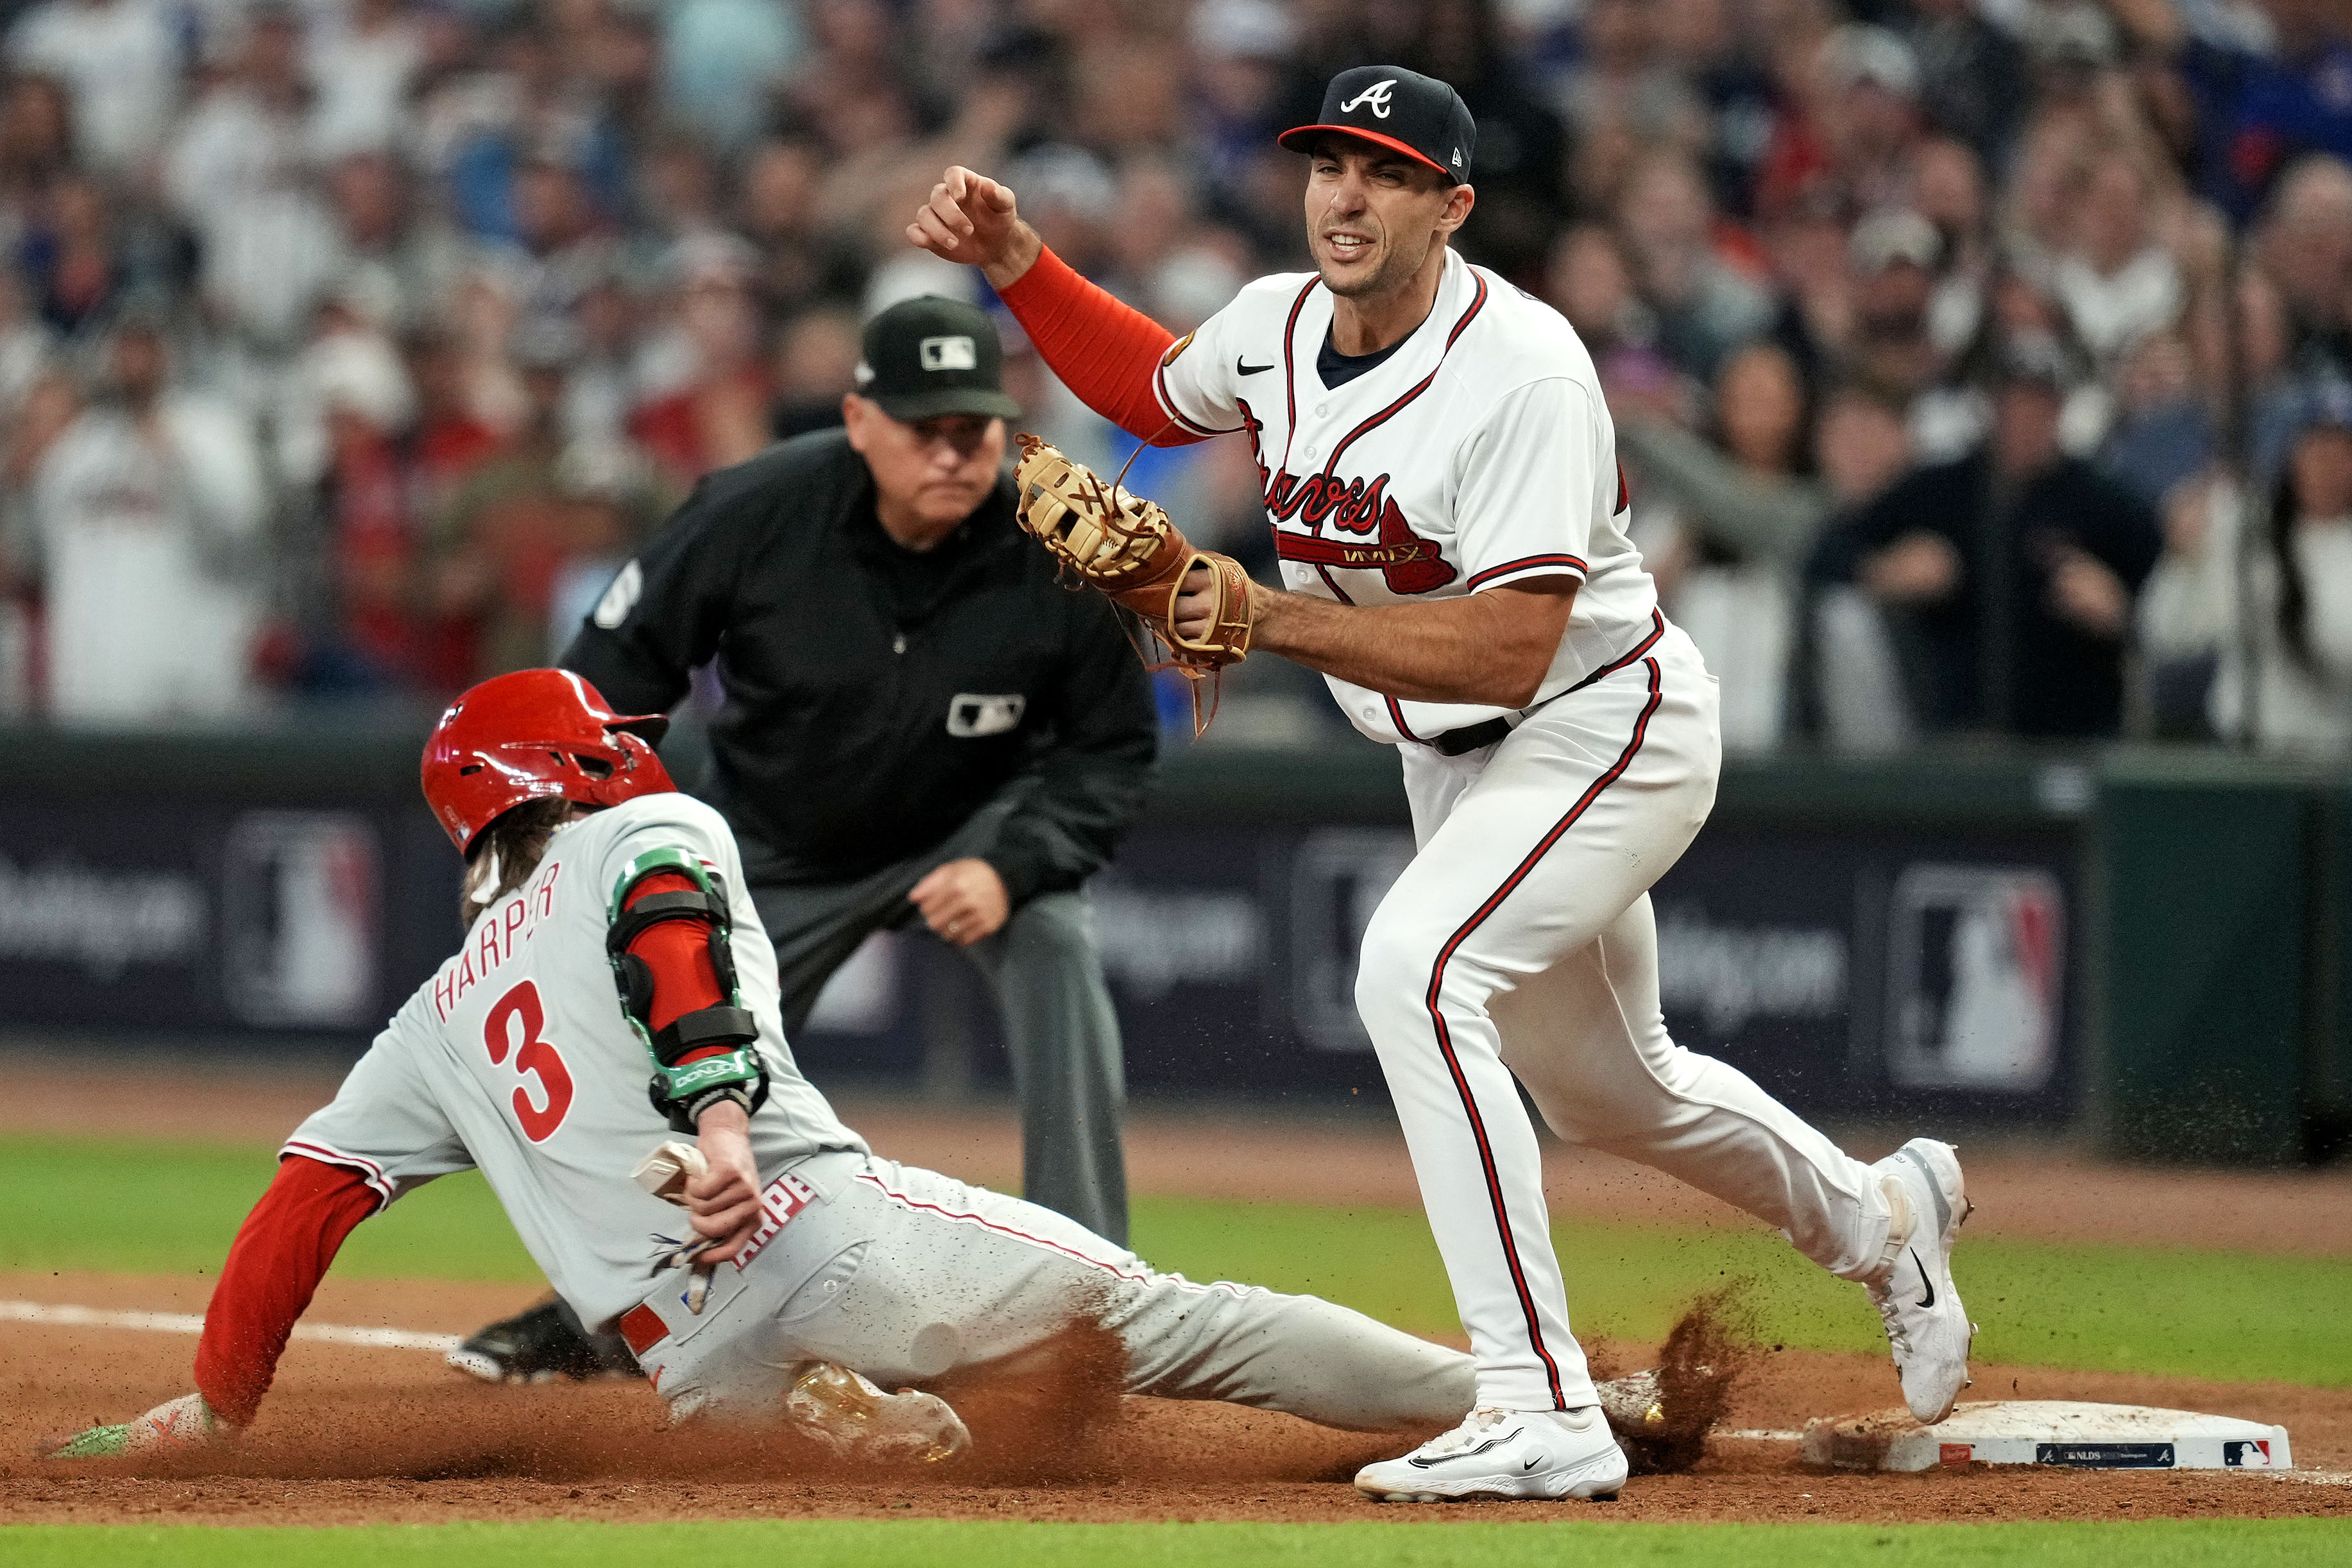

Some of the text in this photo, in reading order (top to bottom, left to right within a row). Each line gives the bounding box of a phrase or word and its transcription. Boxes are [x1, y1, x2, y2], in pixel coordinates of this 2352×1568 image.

[1341, 80, 1397, 119] A
[436, 862, 559, 1024] HARPR
[484, 980, 573, 1143] 3
[2076, 1451, 2101, 1461] NLDS
